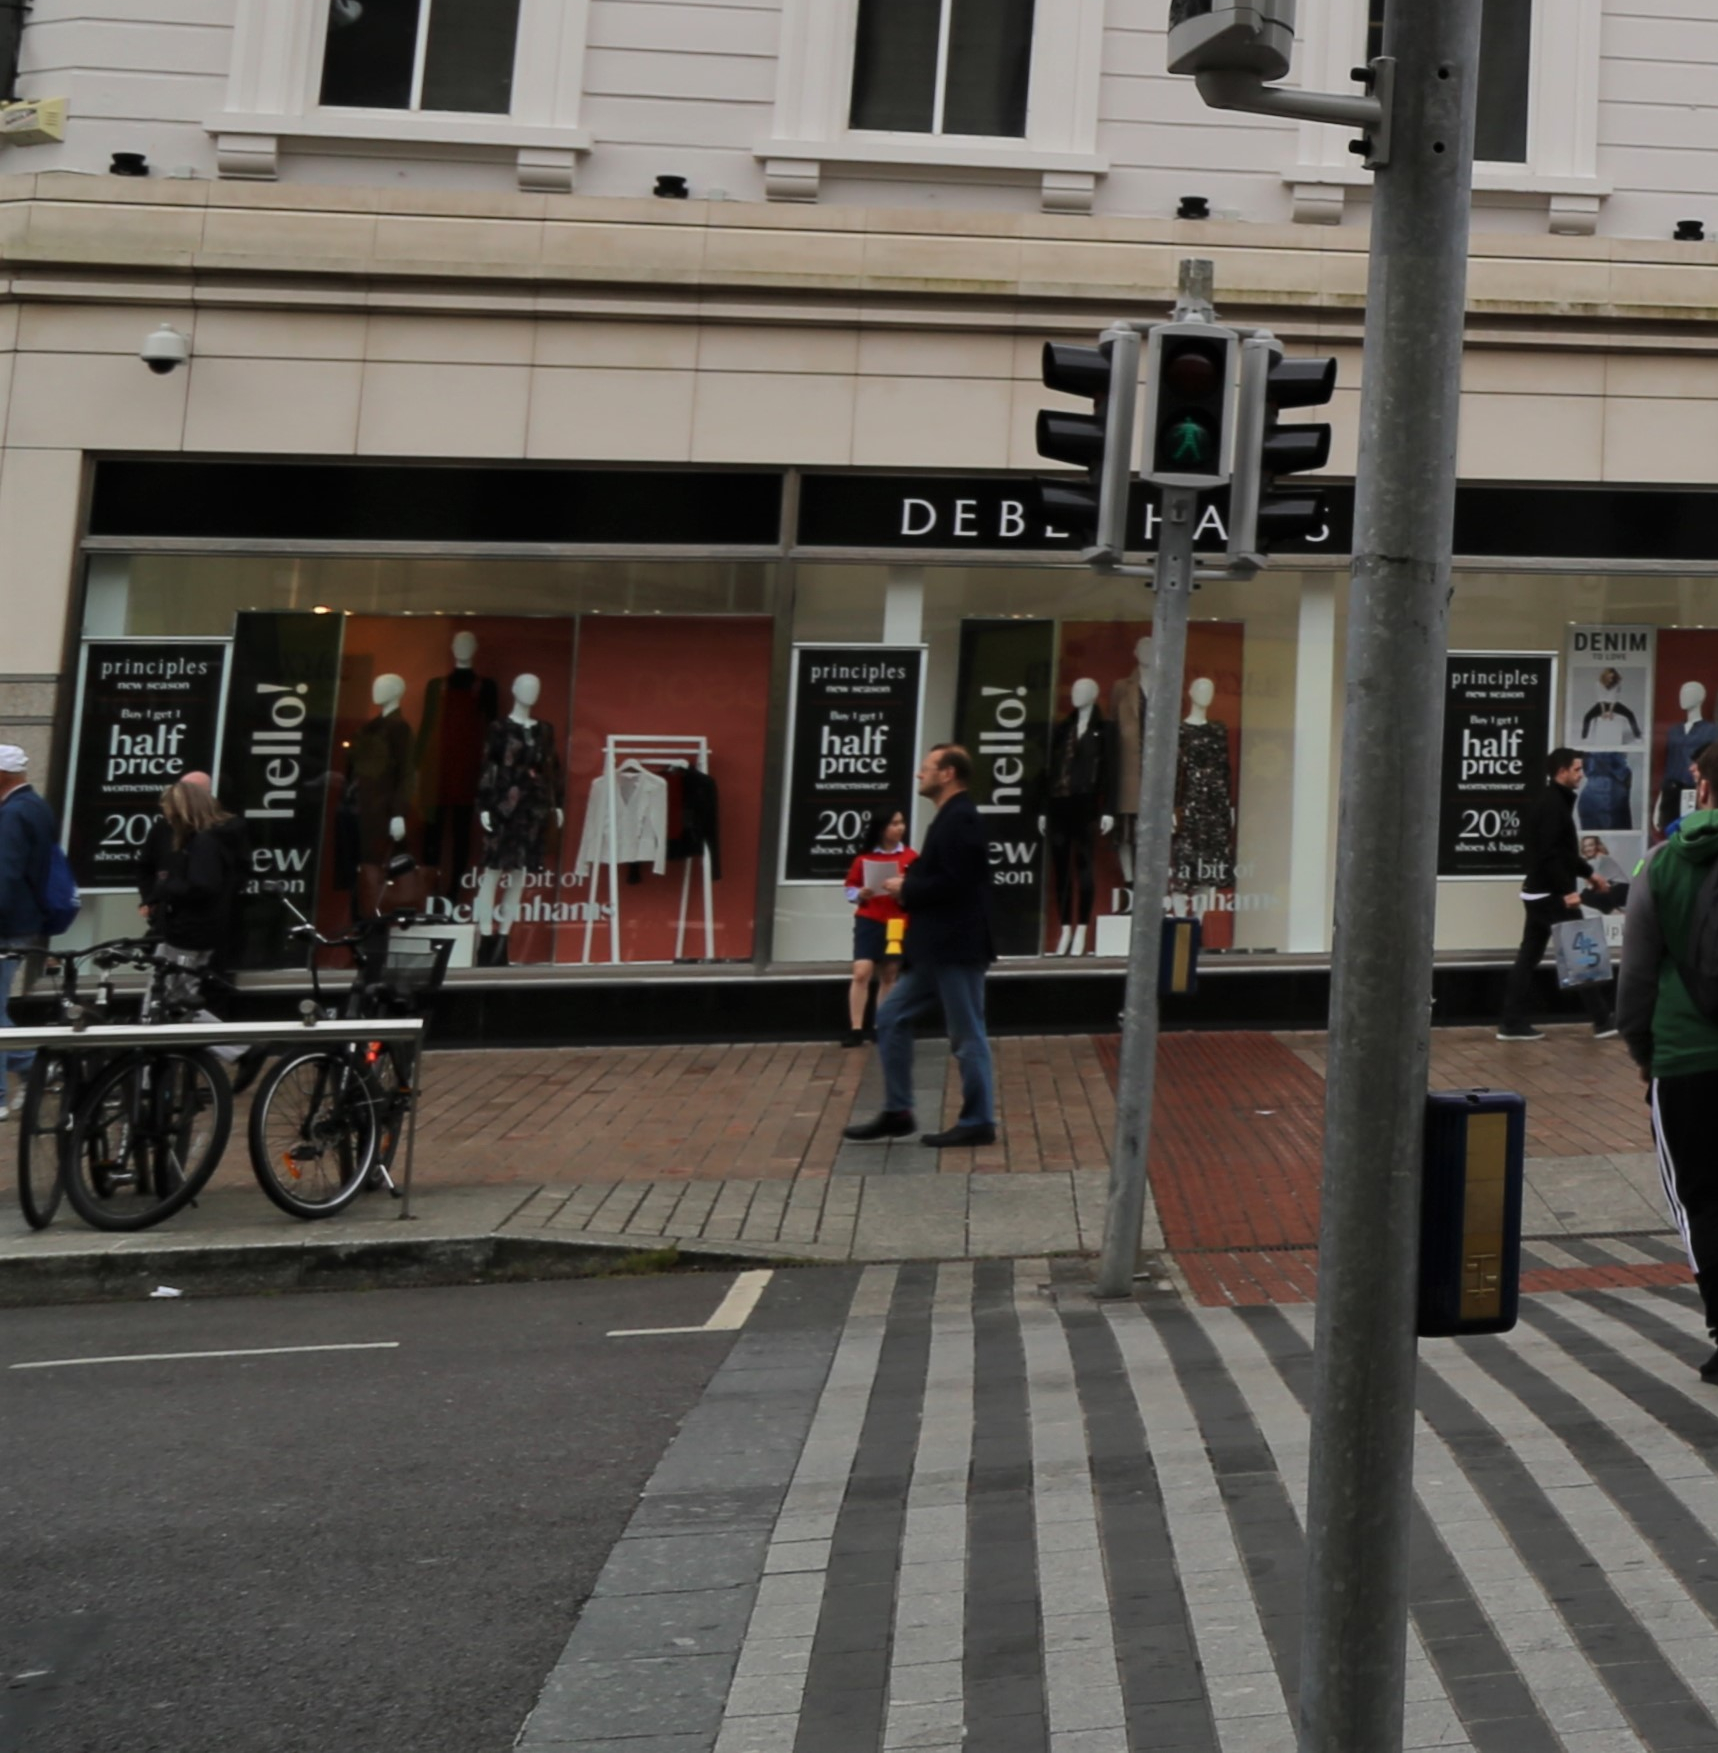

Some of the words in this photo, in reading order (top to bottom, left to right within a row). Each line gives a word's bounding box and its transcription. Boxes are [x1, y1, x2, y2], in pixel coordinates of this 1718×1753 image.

[1574, 632, 1647, 651] DENIM
[101, 658, 208, 680] principles
[811, 662, 906, 683] principles
[117, 681, 142, 690] new
[146, 680, 190, 690] season
[826, 685, 848, 693] new
[852, 685, 891, 693] season
[1452, 670, 1538, 689] principles
[1465, 691, 1487, 699] new
[1490, 691, 1525, 699] season
[121, 709, 142, 721] Buy
[153, 709, 173, 722] get
[830, 710, 849, 721] Buy
[859, 711, 876, 722] get
[1470, 715, 1488, 726] Buy
[1497, 716, 1512, 726] get
[110, 724, 187, 756] half
[821, 725, 890, 756] half
[976, 686, 1027, 813] hello!
[1463, 729, 1524, 758] half
[244, 683, 308, 818] hello!
[107, 756, 184, 781] price
[819, 756, 887, 780] price
[1462, 758, 1523, 781] price
[102, 784, 173, 793] womensw
[815, 782, 889, 791] womenswear
[1458, 782, 1525, 791] womenswear
[99, 813, 164, 846] 20
[1458, 809, 1520, 838] 20%
[94, 851, 131, 862] shoes
[811, 846, 843, 855] shoes
[988, 842, 1037, 865] ew
[1455, 842, 1485, 852] shoes
[1500, 842, 1525, 853] bags
[252, 848, 311, 872] ew
[1198, 858, 1228, 879] bit
[993, 870, 1033, 885] son
